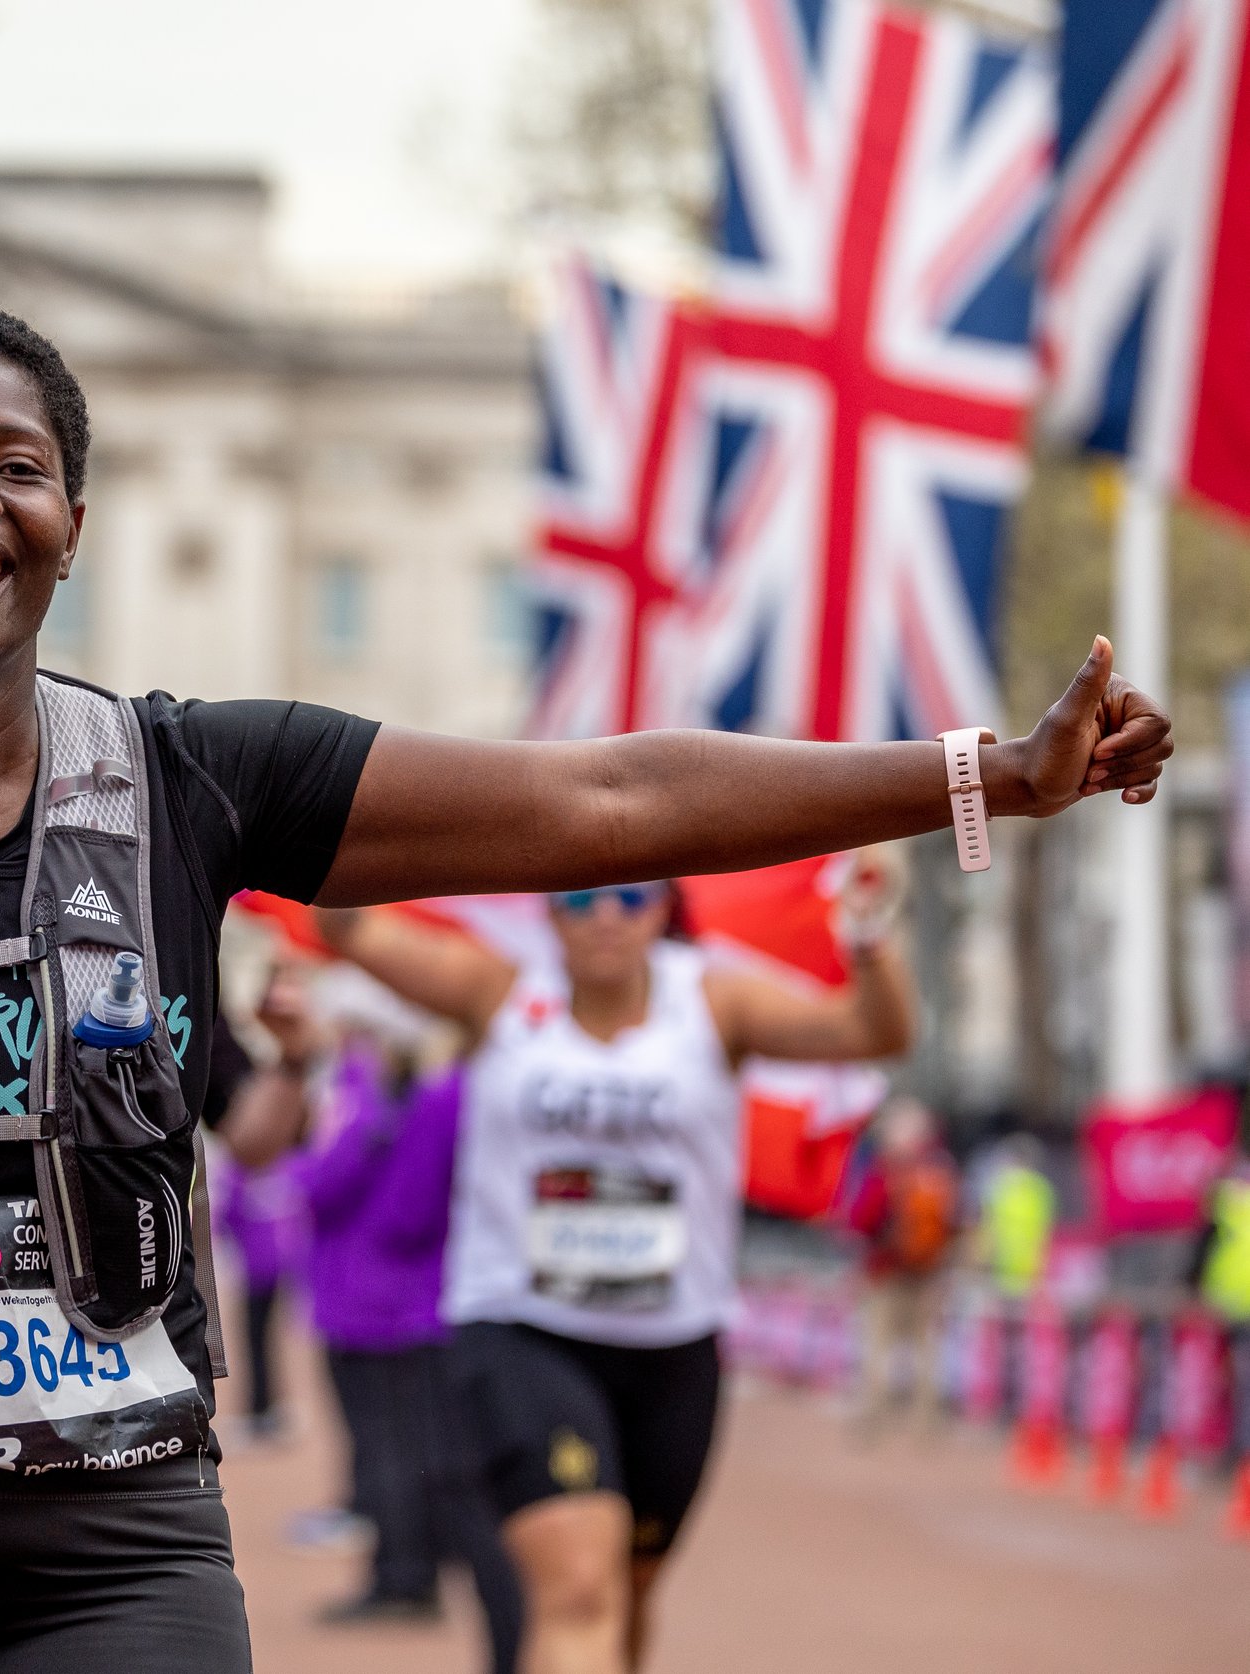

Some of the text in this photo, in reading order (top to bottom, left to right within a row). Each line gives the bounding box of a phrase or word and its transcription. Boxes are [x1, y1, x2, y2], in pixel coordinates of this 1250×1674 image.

[64, 904, 121, 926] AONIJIE
[7, 1199, 41, 1218] TA
[13, 1224, 48, 1245] CON
[136, 1197, 156, 1289] AONIJIE
[15, 1250, 50, 1271] SERV
[83, 1436, 183, 1470] balance
